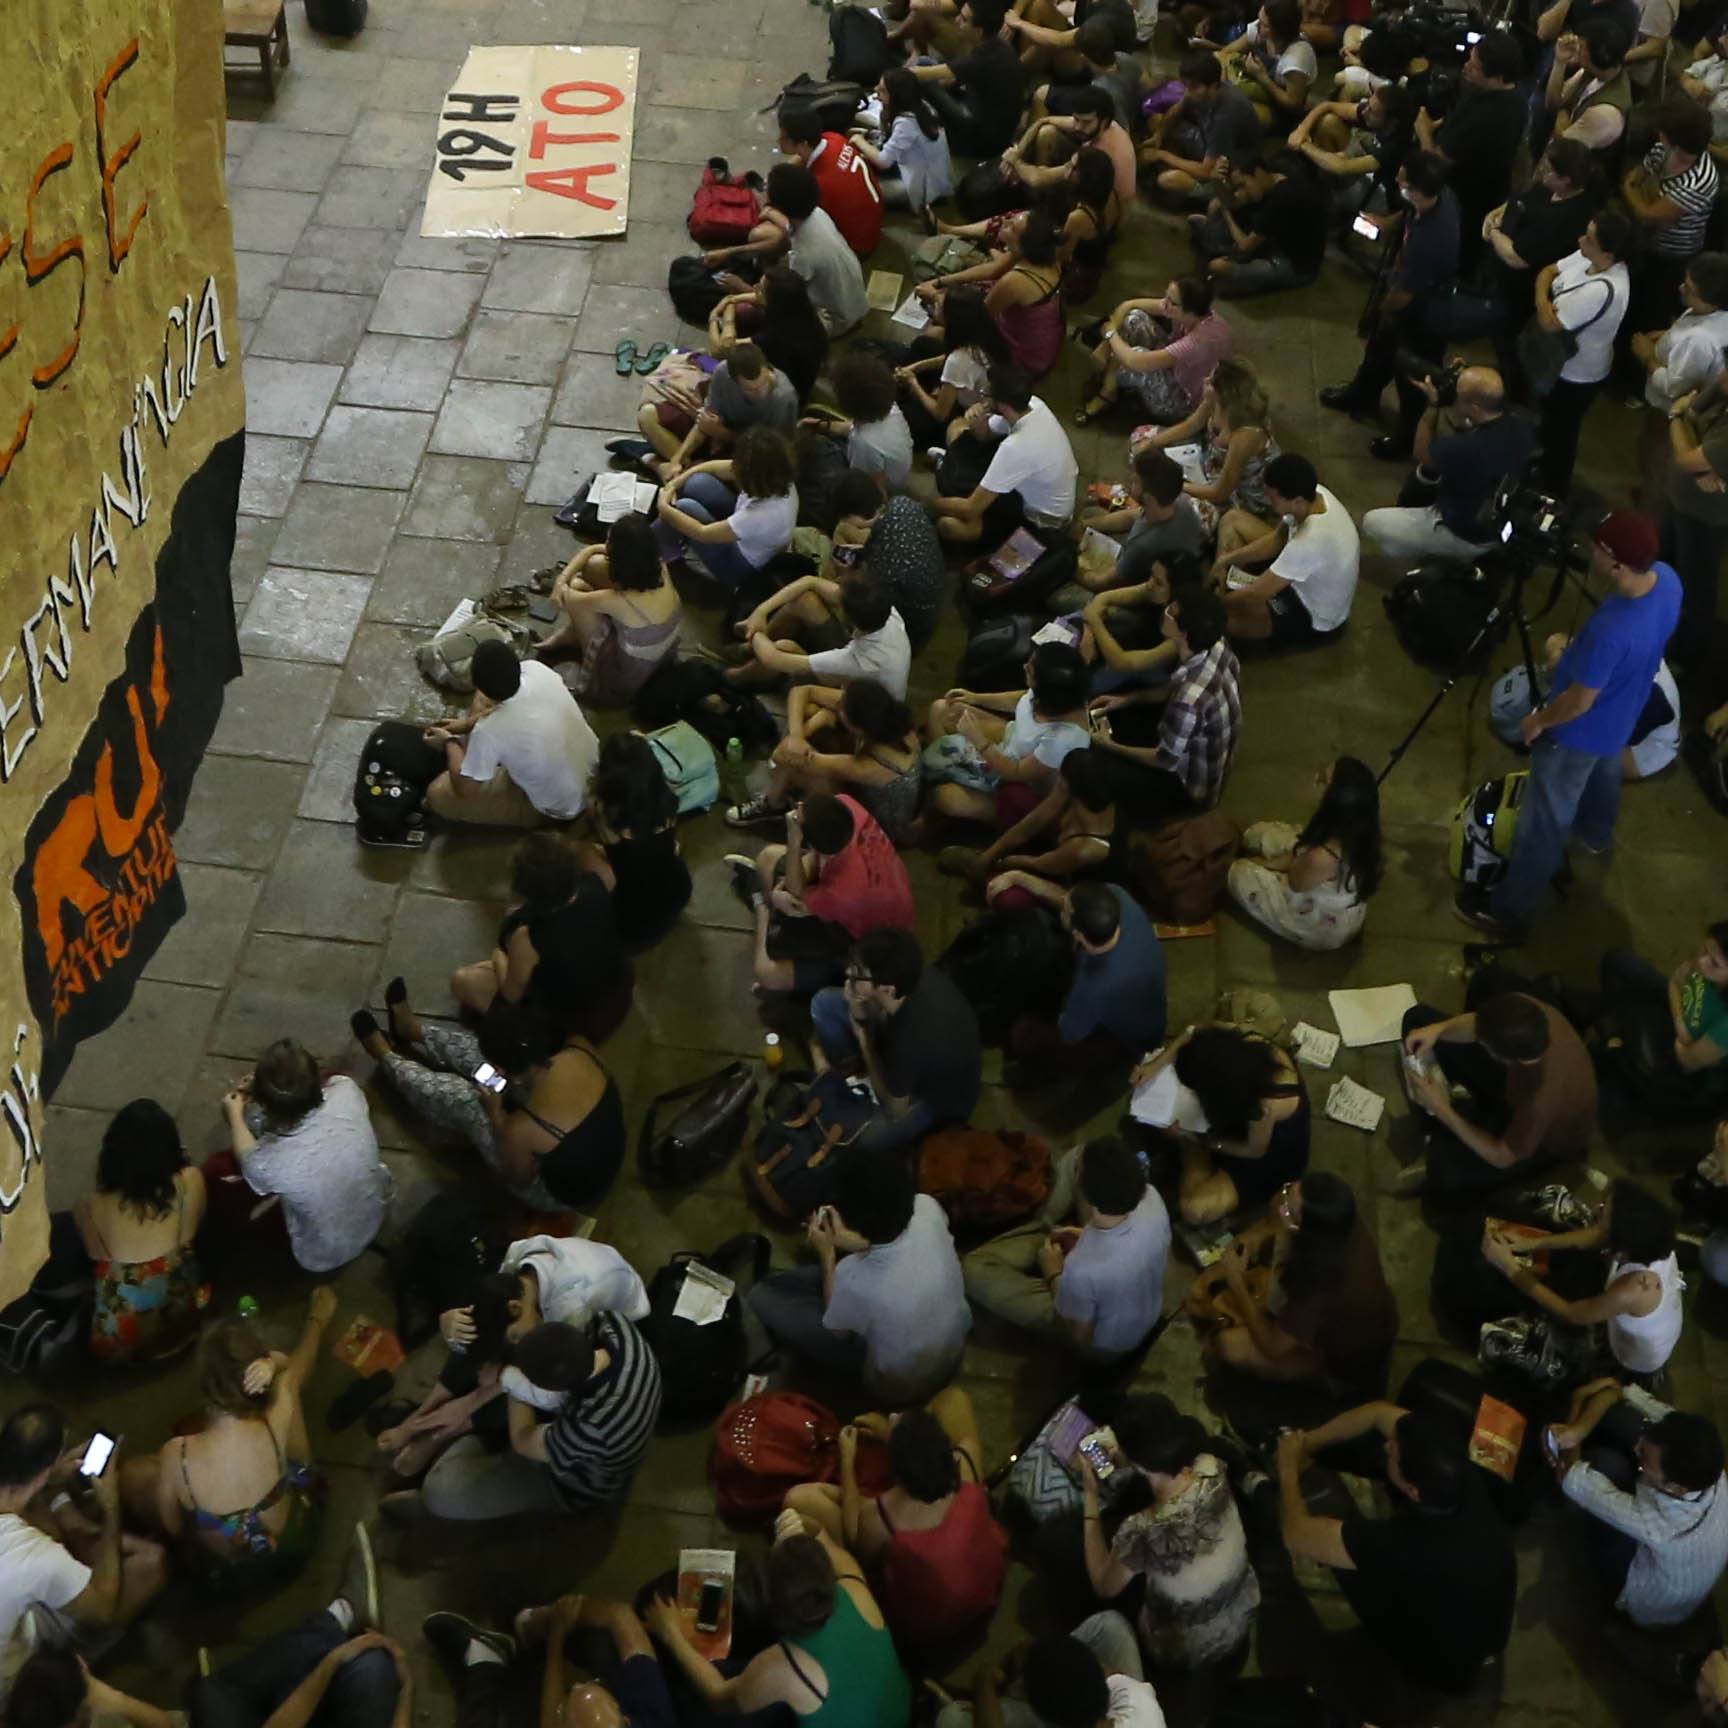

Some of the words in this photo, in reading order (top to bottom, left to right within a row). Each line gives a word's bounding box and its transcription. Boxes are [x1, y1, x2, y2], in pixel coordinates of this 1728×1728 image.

[92, 38, 151, 273] E
[436, 92, 520, 182] 19H
[525, 79, 625, 211] ATO
